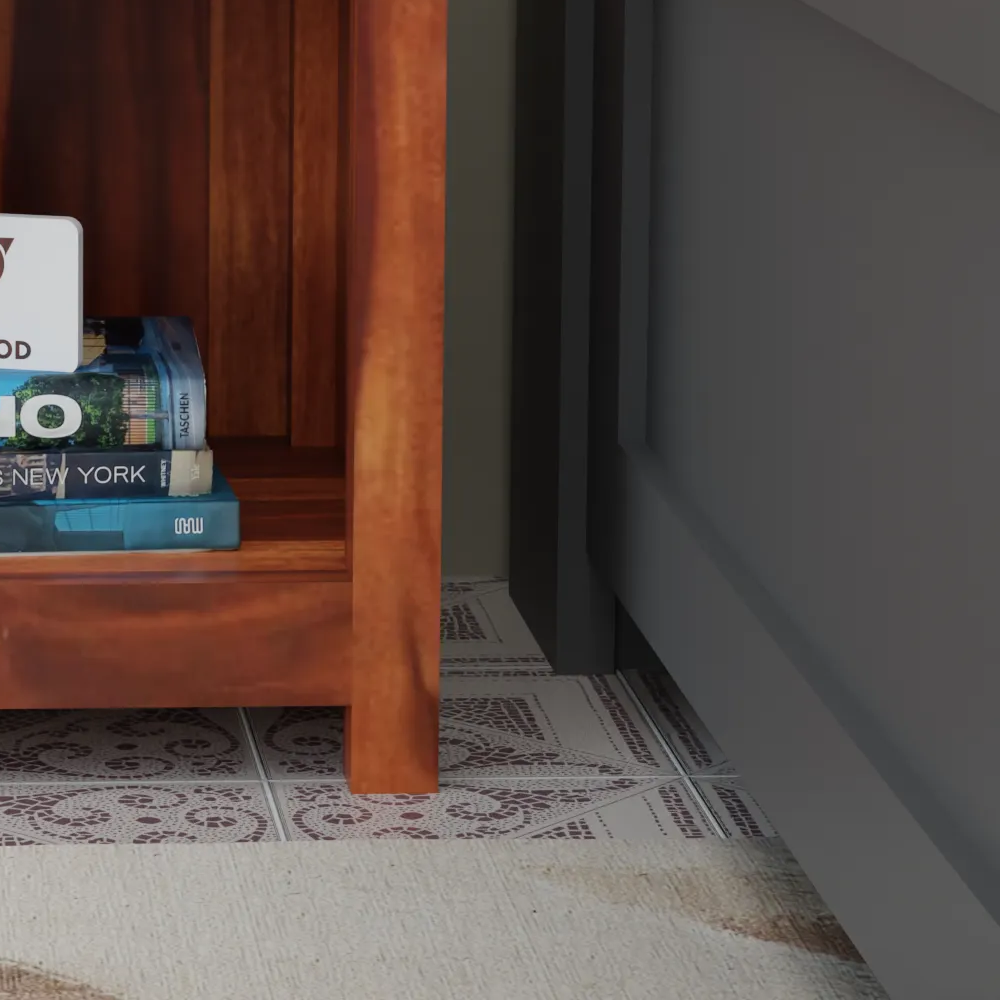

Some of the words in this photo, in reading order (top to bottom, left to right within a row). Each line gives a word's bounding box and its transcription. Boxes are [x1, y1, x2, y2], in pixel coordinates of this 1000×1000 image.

[179, 392, 190, 439] TASCHEN
[12, 467, 70, 486] NEW
[77, 465, 147, 485] YORK
